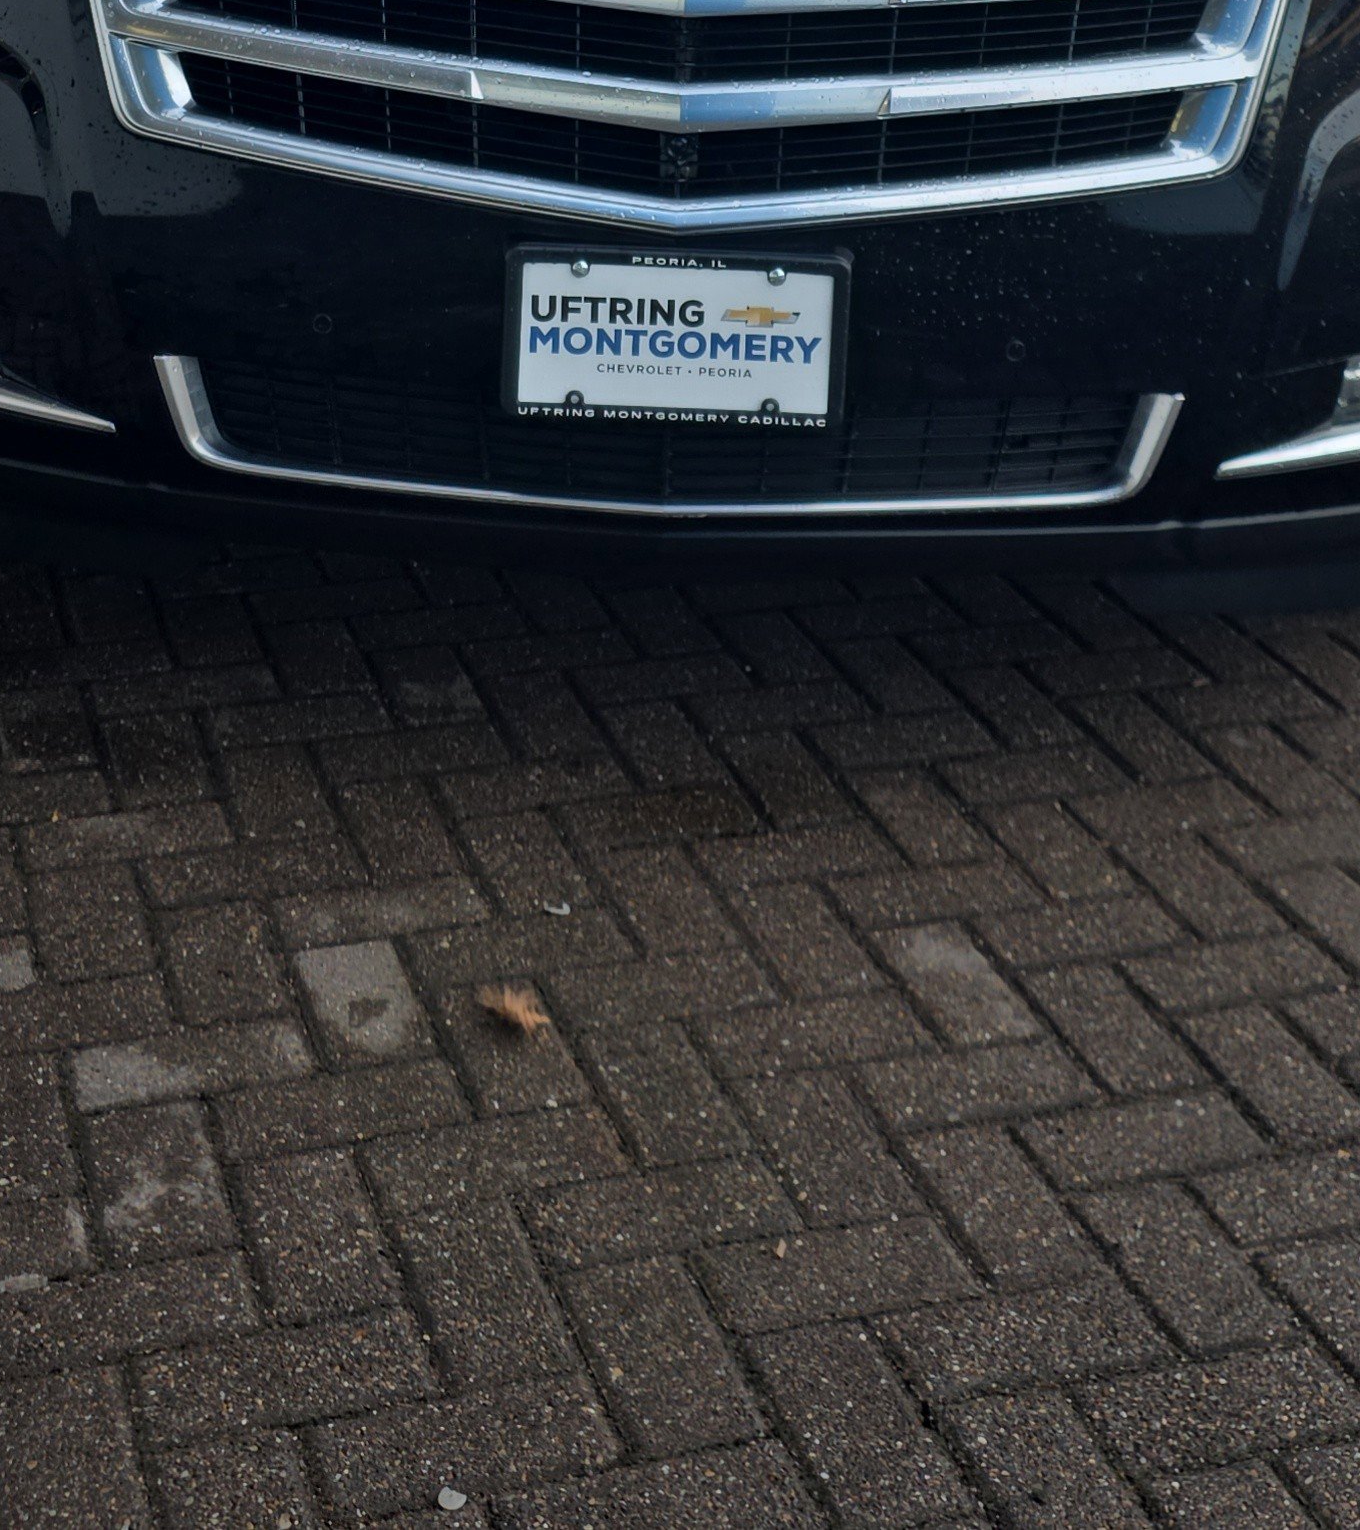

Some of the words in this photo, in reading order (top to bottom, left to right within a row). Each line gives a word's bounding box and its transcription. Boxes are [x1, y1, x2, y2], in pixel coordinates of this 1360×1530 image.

[711, 260, 726, 269] IL
[530, 294, 705, 328] UFTRING
[528, 326, 822, 365] MONTGOMERY
[596, 363, 681, 376] CHEVROLET
[698, 368, 752, 378] PEORIA
[517, 406, 595, 419] UFTRING
[603, 411, 729, 423] MONTGOMERY
[737, 415, 827, 427] CADILLAC
